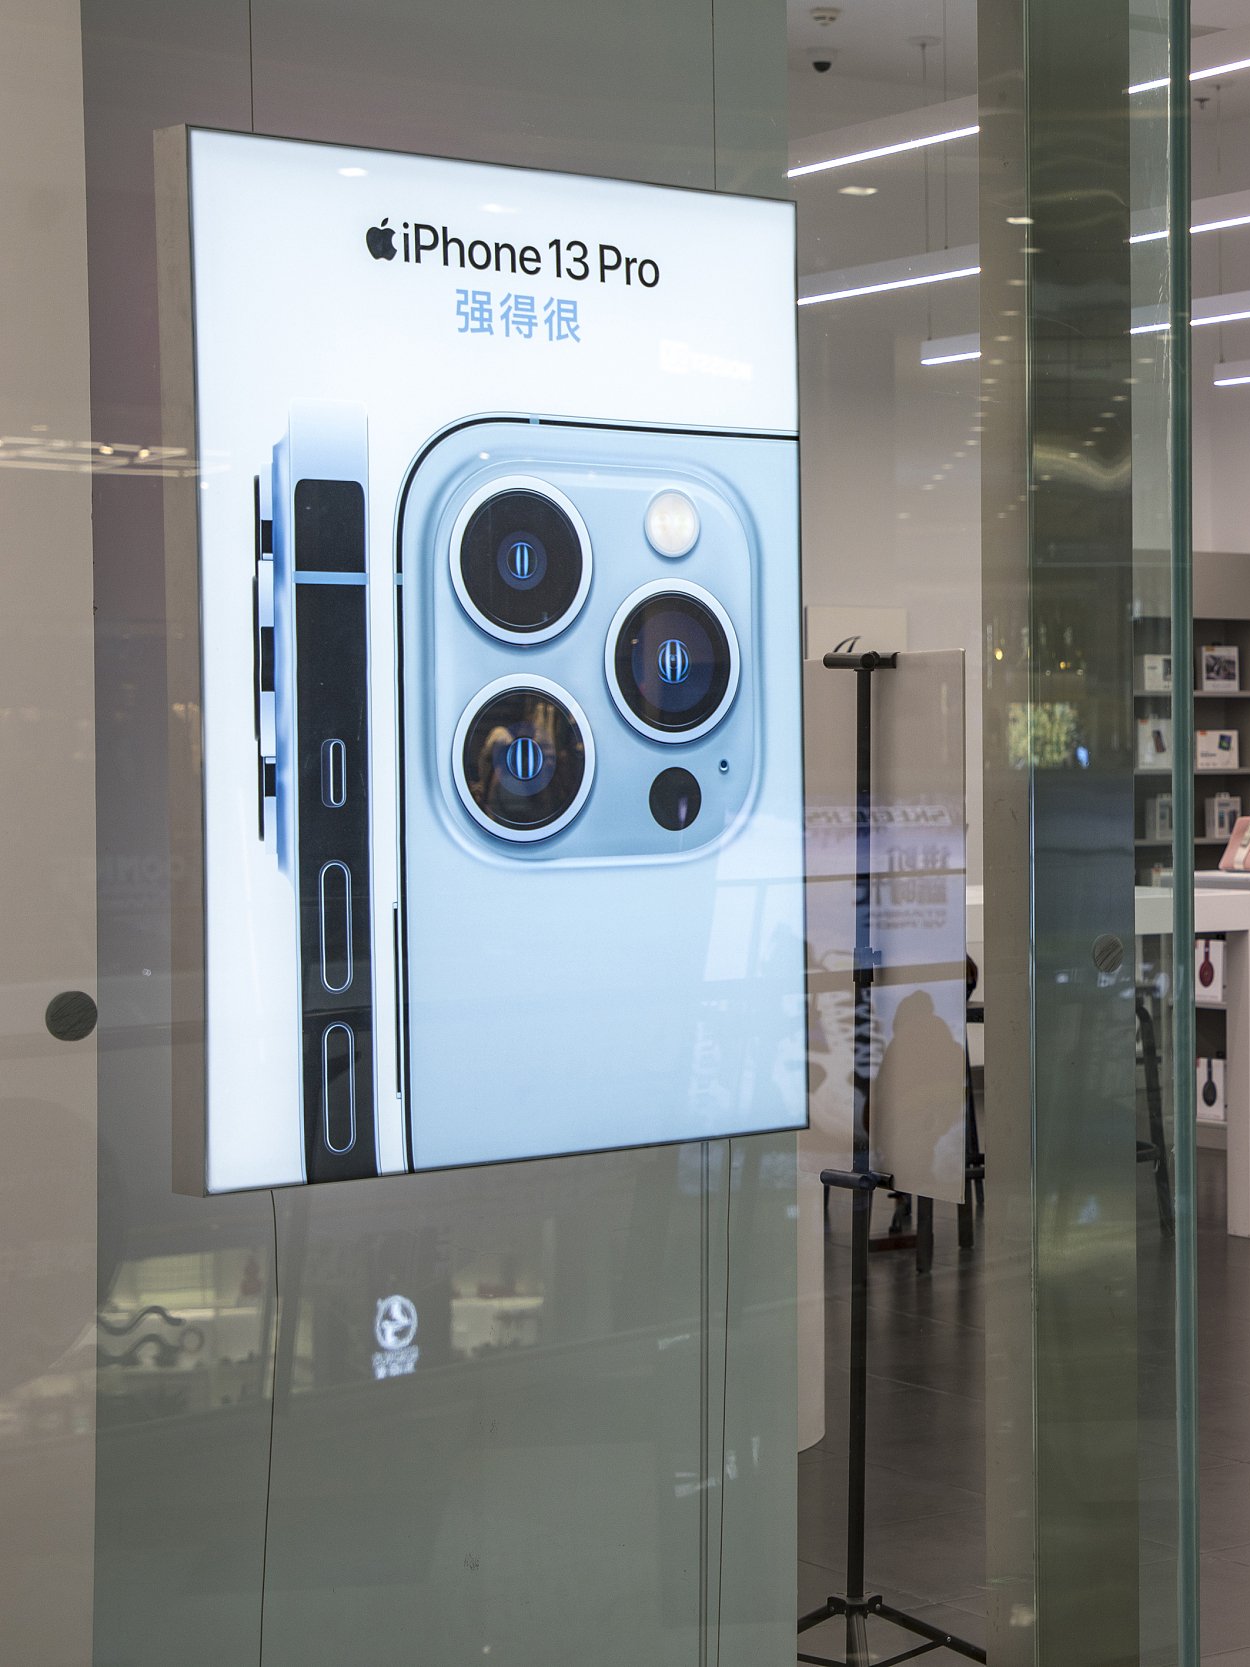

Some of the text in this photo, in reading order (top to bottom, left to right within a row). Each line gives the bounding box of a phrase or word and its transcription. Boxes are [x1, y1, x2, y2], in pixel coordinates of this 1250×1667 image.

[402, 222, 660, 288] iPhone 13 Pro
[455, 288, 581, 343] 强得很
